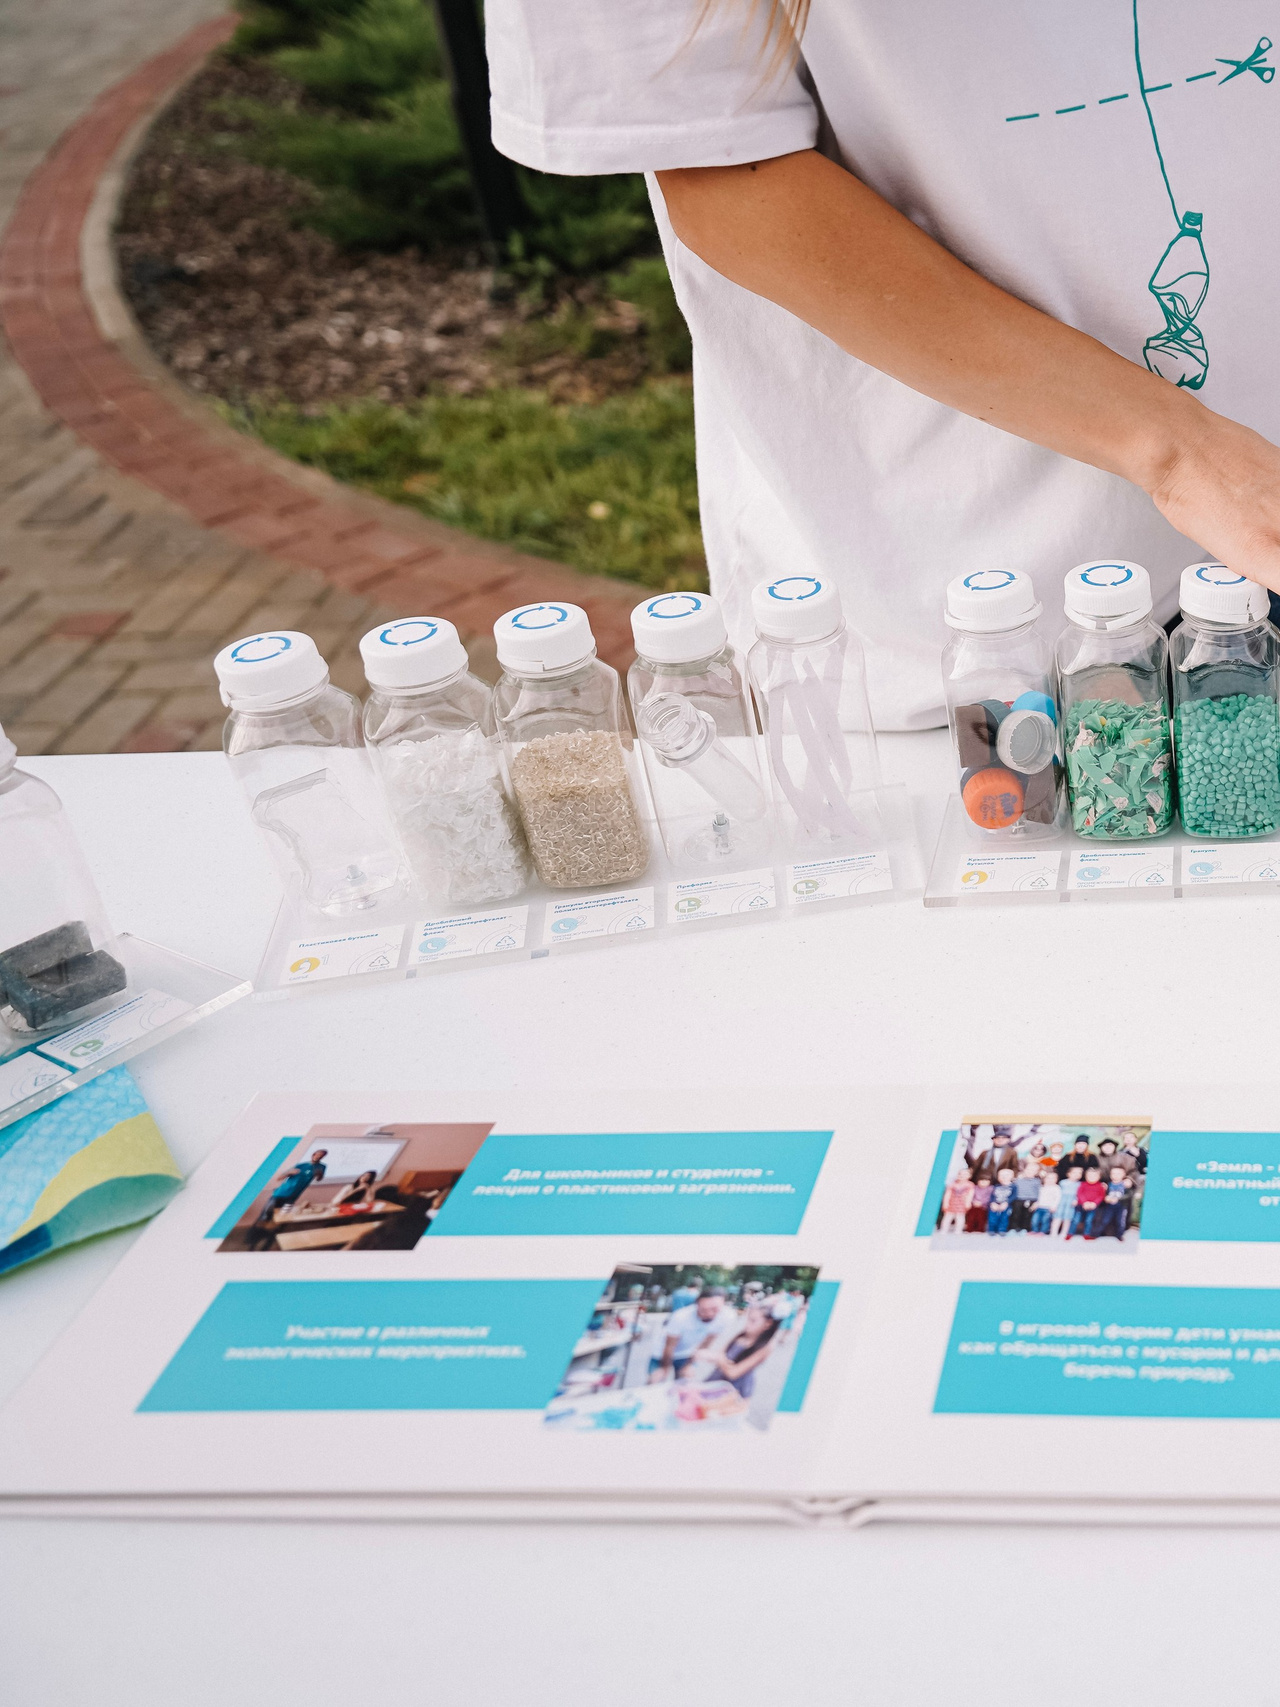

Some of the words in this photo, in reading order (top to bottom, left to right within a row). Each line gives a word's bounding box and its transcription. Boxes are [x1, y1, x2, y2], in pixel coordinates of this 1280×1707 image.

[501, 1167, 542, 1182] Для
[543, 1168, 653, 1181] школьников
[655, 1168, 669, 1180] и
[670, 1167, 762, 1182] студентов
[1195, 1160, 1263, 1174] «Земля
[472, 1184, 540, 1197] лекции
[541, 1184, 555, 1196] о
[556, 1183, 675, 1197] пластиковом
[677, 1182, 796, 1197] загрязнении.
[1257, 1194, 1280, 1207] от
[284, 1324, 366, 1341] Участие
[366, 1326, 380, 1340] в
[378, 1325, 492, 1342] различных
[999, 1319, 1015, 1337] В
[1016, 1320, 1101, 1340] игровой
[1103, 1322, 1174, 1342] форме
[1174, 1326, 1227, 1343] дети
[224, 1345, 374, 1362] экологических
[957, 1339, 998, 1356] как
[998, 1339, 1124, 1360] обращаться
[1125, 1344, 1140, 1360] с
[1140, 1345, 1234, 1363] мусором
[1234, 1346, 1251, 1361] и
